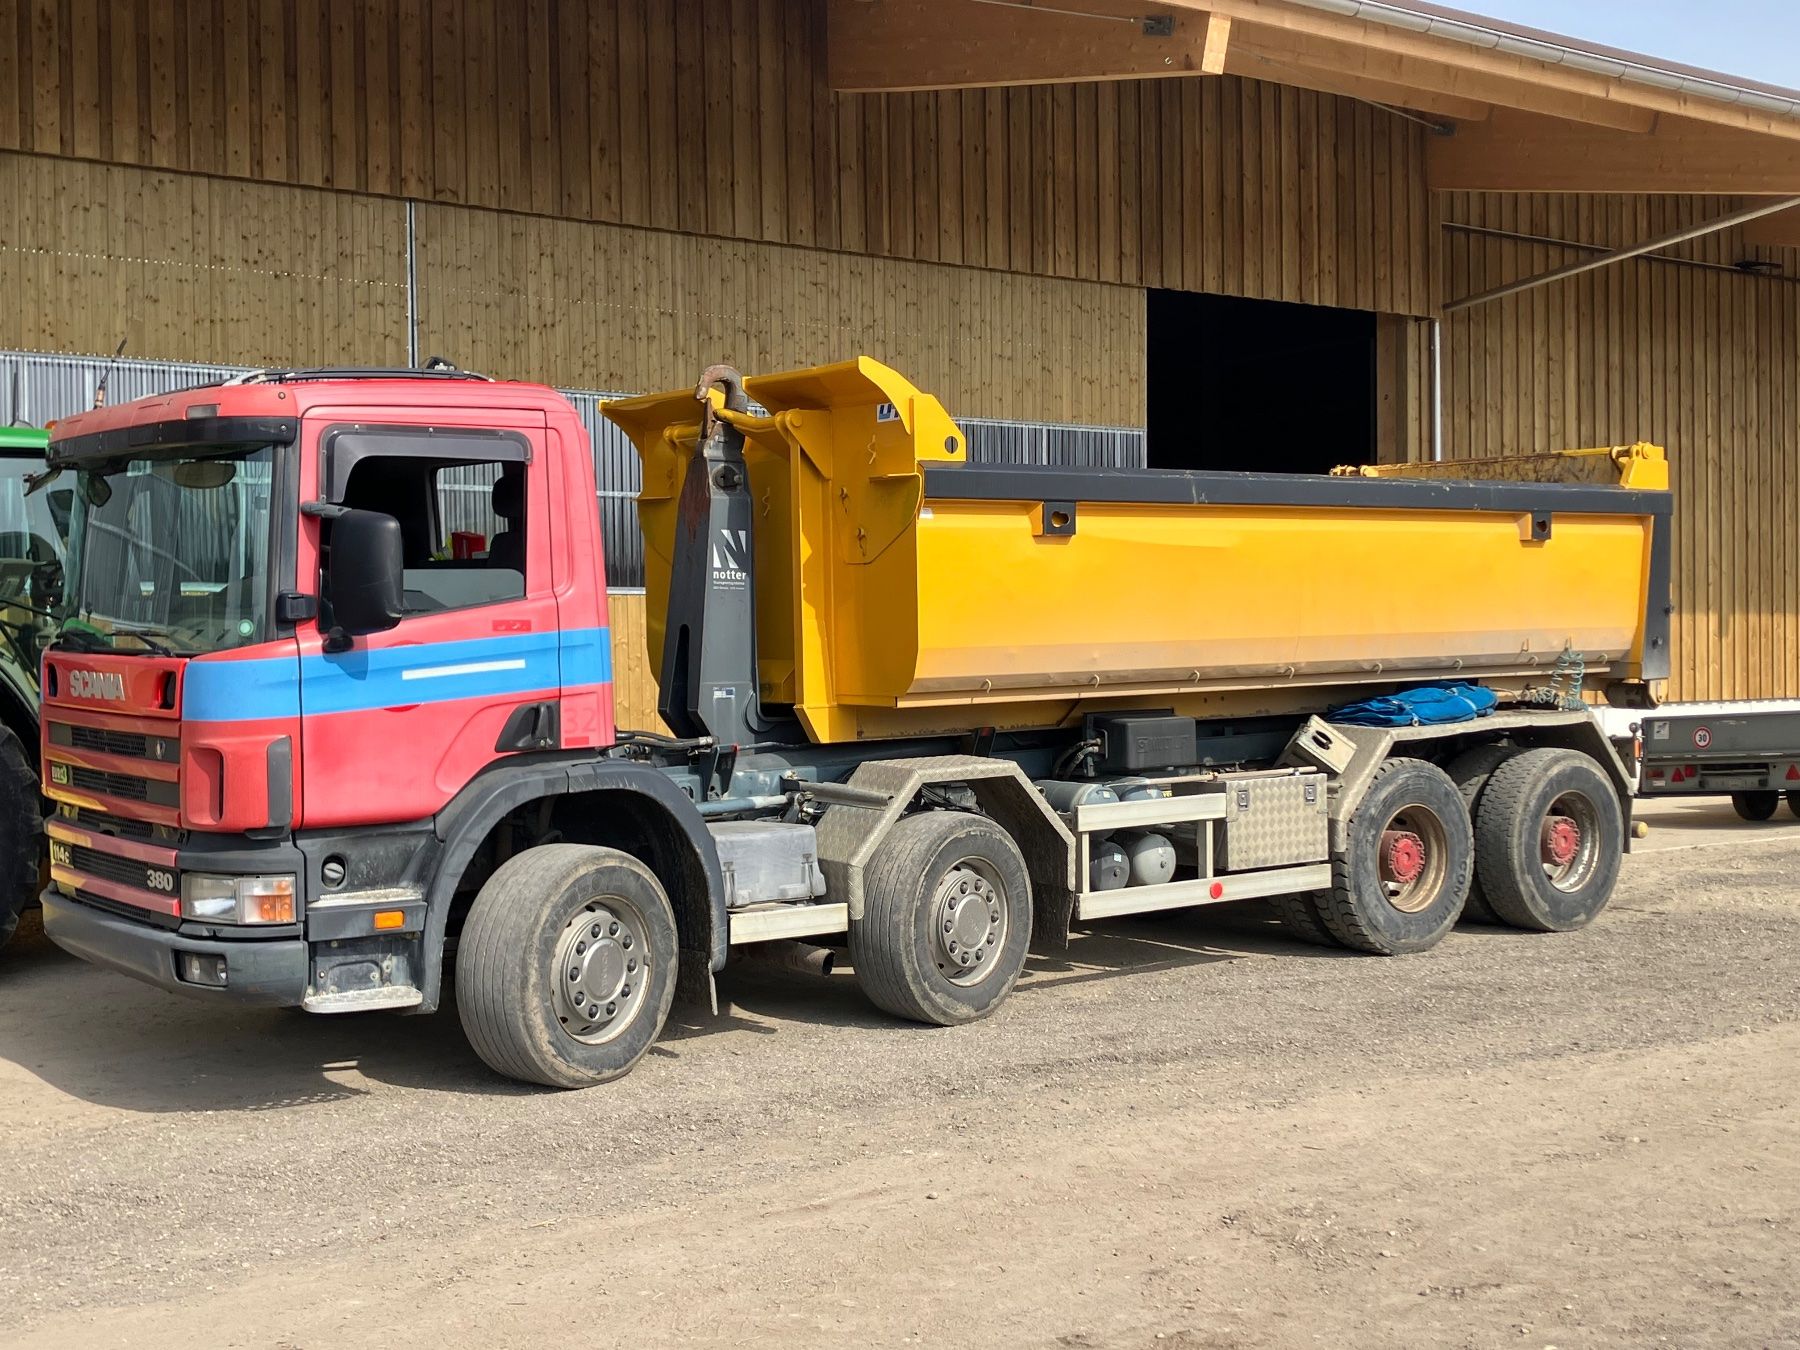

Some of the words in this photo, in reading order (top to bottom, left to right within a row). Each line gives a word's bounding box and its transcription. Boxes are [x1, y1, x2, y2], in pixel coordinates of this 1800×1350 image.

[713, 570, 746, 580] notter
[70, 669, 125, 701] SCANIA
[1698, 734, 1707, 743] 30
[147, 869, 173, 891] 380
